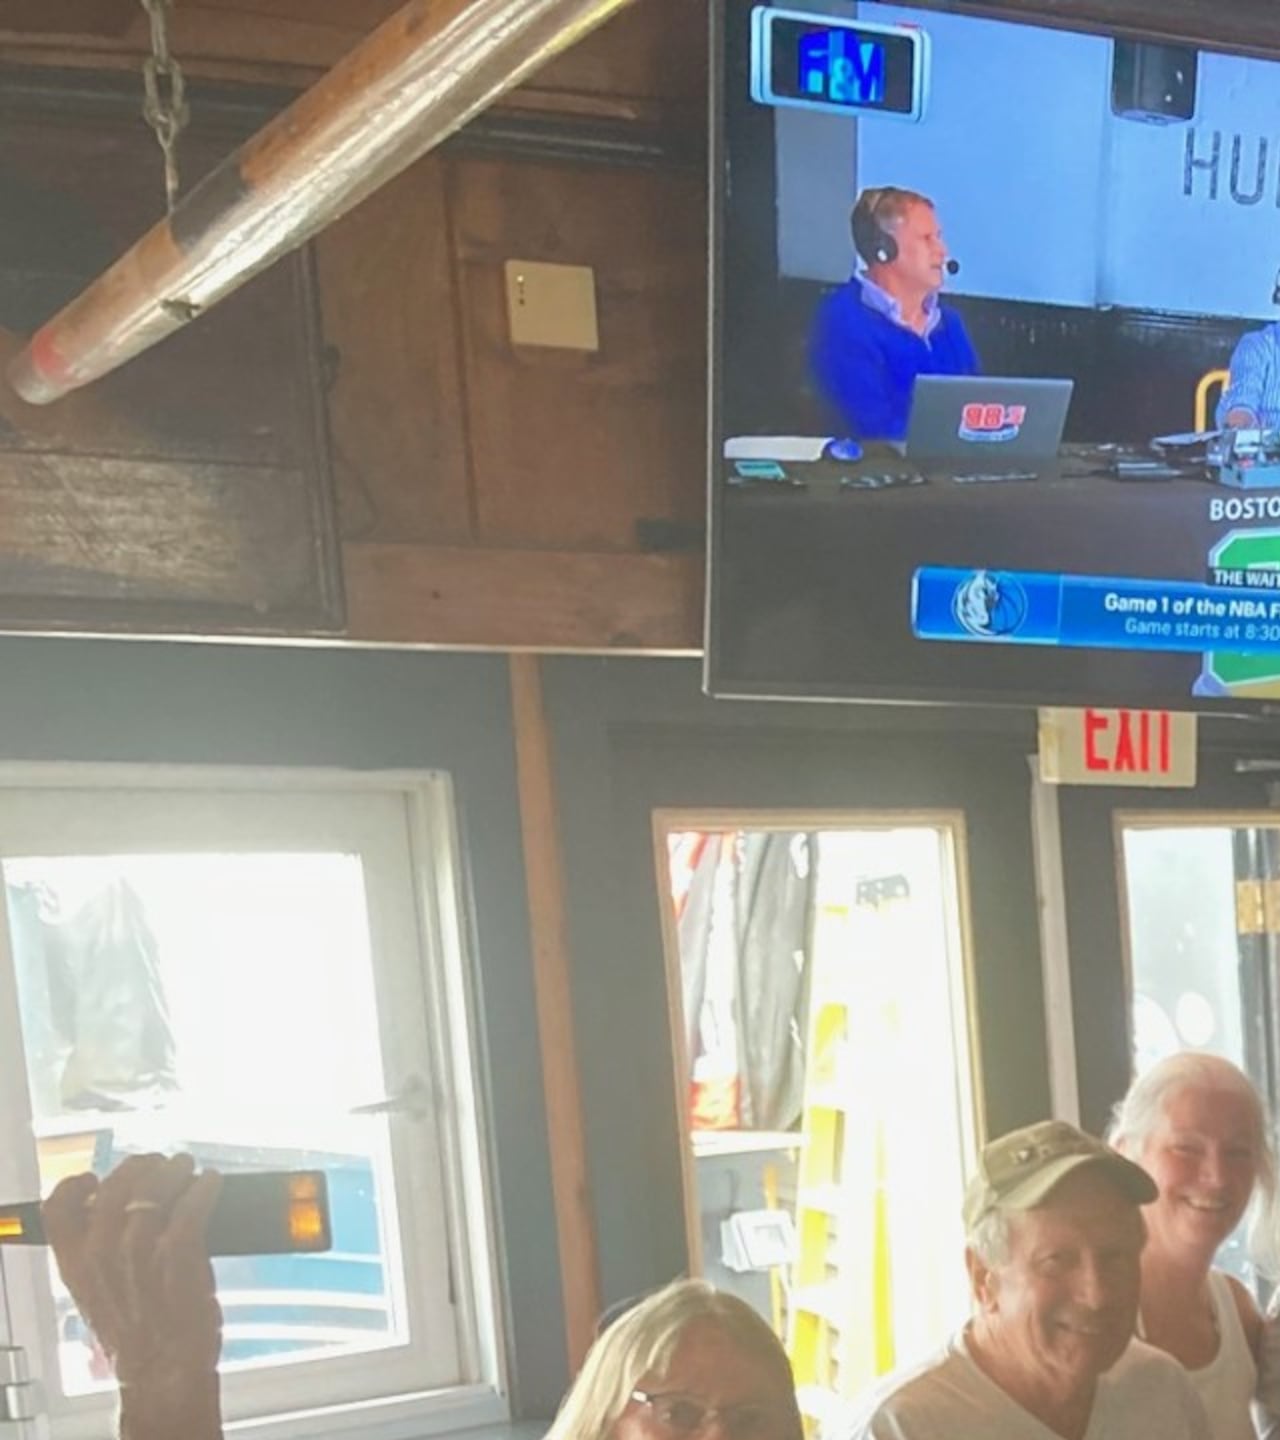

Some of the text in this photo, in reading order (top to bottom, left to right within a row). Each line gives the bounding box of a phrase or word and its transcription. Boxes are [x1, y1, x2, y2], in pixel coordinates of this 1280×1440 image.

[1213, 569, 1244, 586] THE
[1104, 593, 1158, 614] Game
[1160, 596, 1169, 614] 1
[1172, 596, 1193, 616] of
[1196, 597, 1226, 617] the
[1228, 599, 1267, 619] NBA
[1124, 617, 1172, 636] Game
[1175, 619, 1220, 639] starts
[1223, 621, 1240, 639] at
[1083, 704, 1171, 773] EXIT
